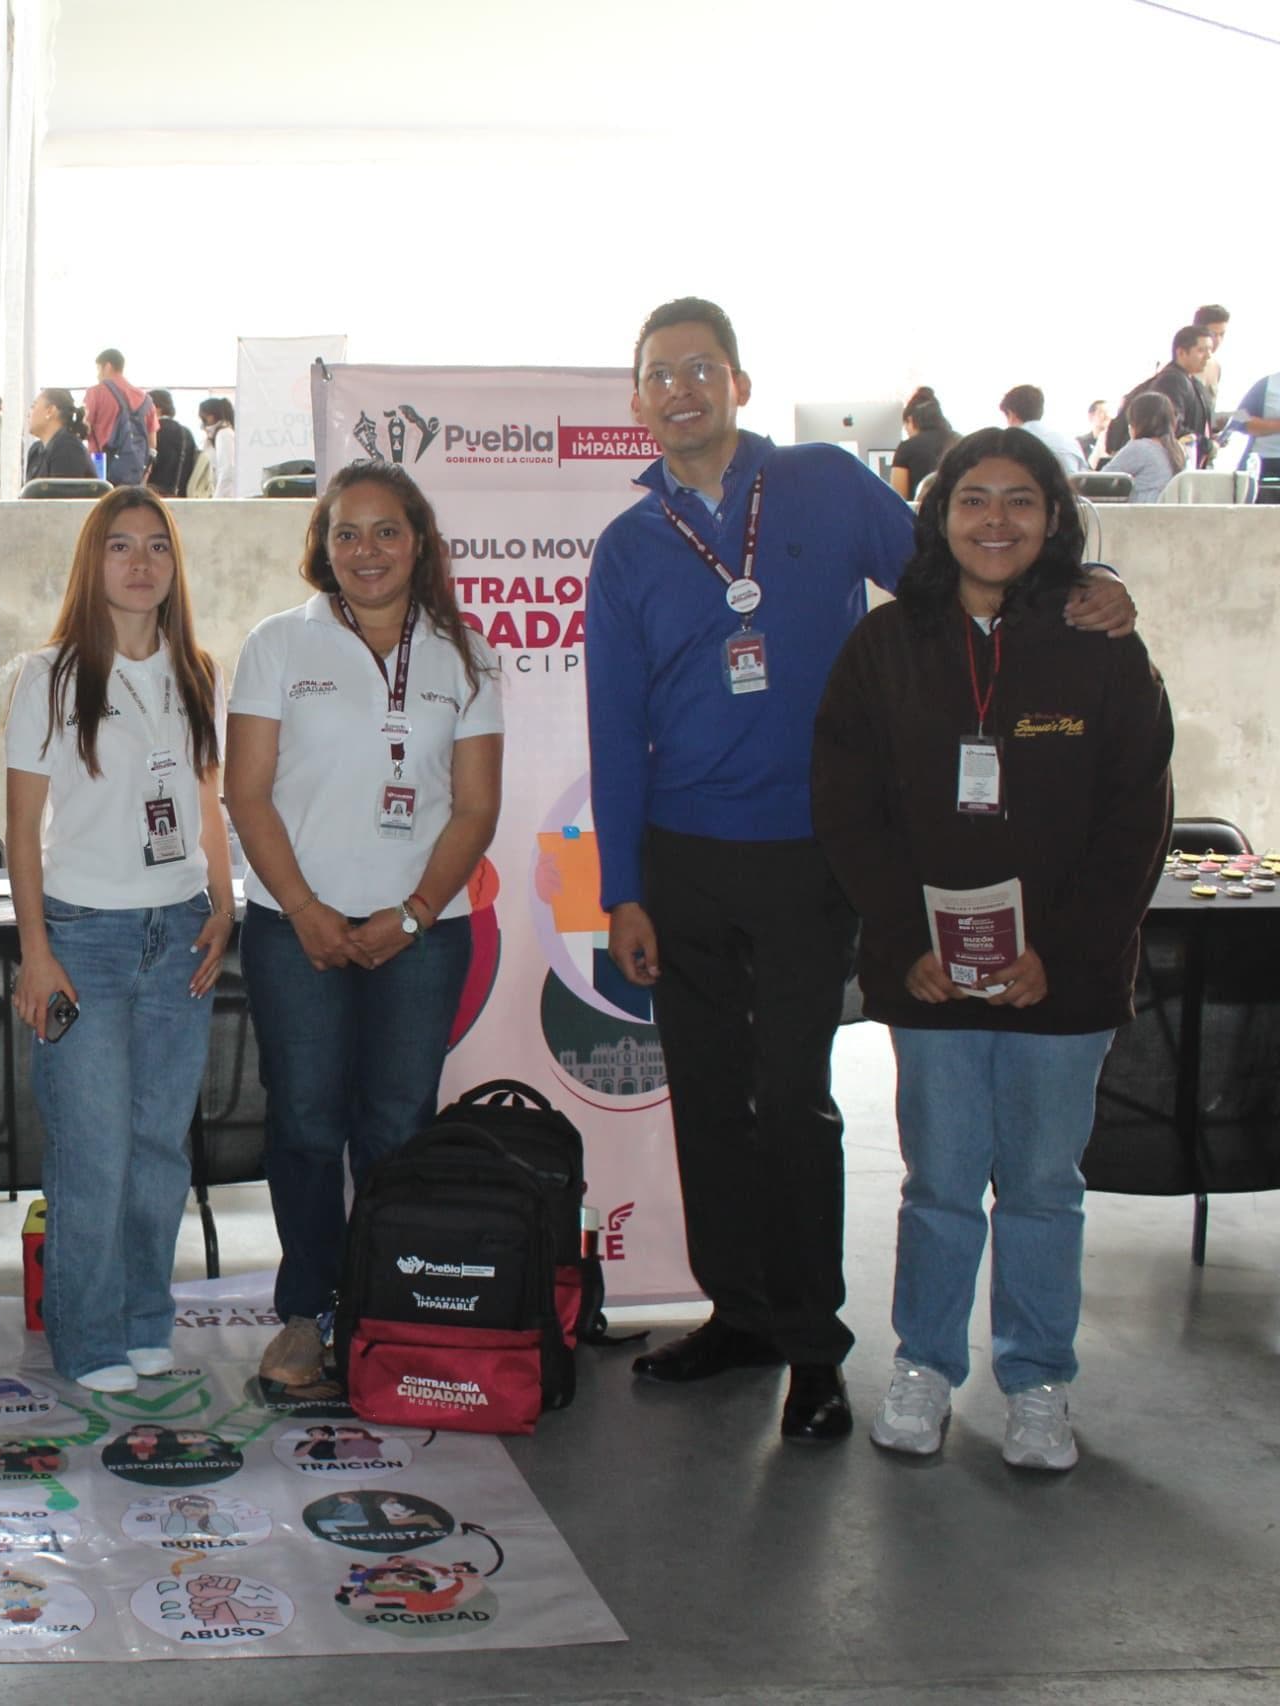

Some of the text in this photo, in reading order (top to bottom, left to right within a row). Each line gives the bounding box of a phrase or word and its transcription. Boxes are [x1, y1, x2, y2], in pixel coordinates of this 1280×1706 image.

[444, 424, 554, 452] Puebla
[578, 431, 654, 441] LA CAPITA
[571, 442, 663, 456] IMPARABL
[446, 456, 554, 464] GOBIERNO DE LA CIUDAD
[450, 538, 596, 560] DULO MOV
[417, 1300, 475, 1312] IMPARABLE
[403, 1375, 480, 1393] CONTRALORÍA
[397, 1383, 489, 1406] CIUDADANA
[107, 1459, 241, 1471] RESPONSABILIDAD
[298, 1458, 404, 1472] TRAICIÓN
[327, 1529, 448, 1543] ENEMISTAD
[161, 1539, 248, 1550] BURLAS
[363, 1610, 490, 1624] SOCIEDAD
[179, 1626, 266, 1641] ABUSO
